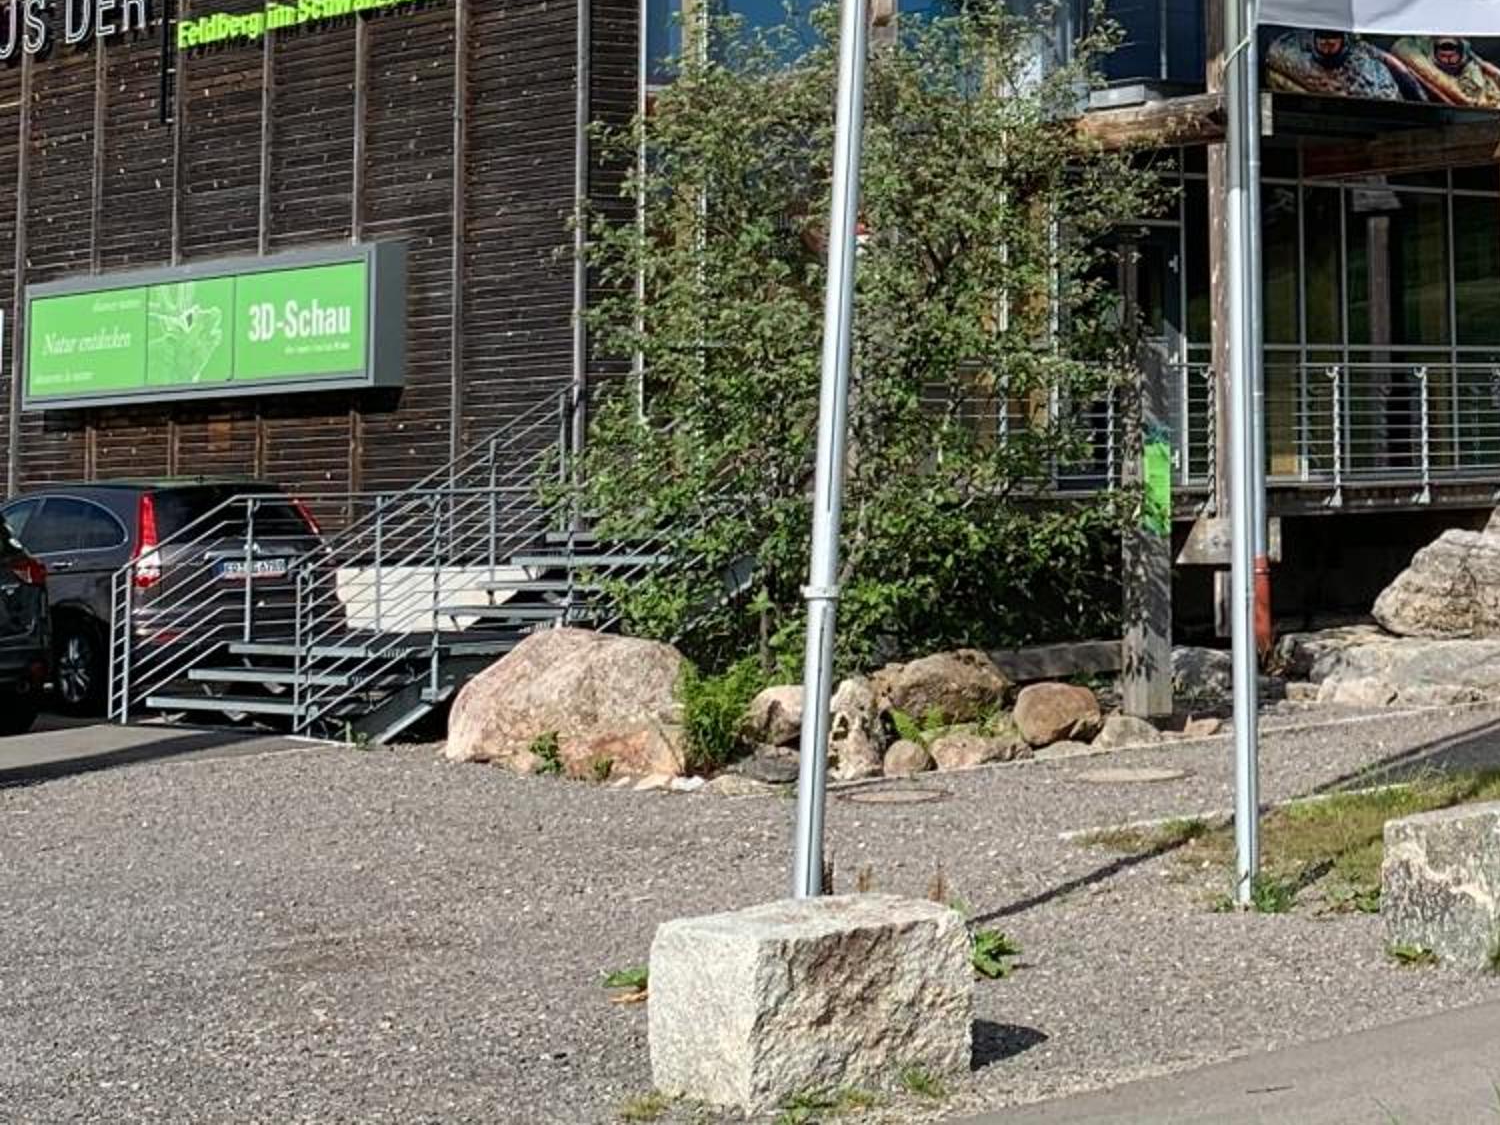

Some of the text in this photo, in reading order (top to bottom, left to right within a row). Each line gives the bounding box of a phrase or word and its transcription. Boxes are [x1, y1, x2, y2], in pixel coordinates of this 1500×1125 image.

[178, 12, 265, 49] Feldberg
[266, 2, 297, 30] im
[248, 299, 351, 342] 3D-Schau
